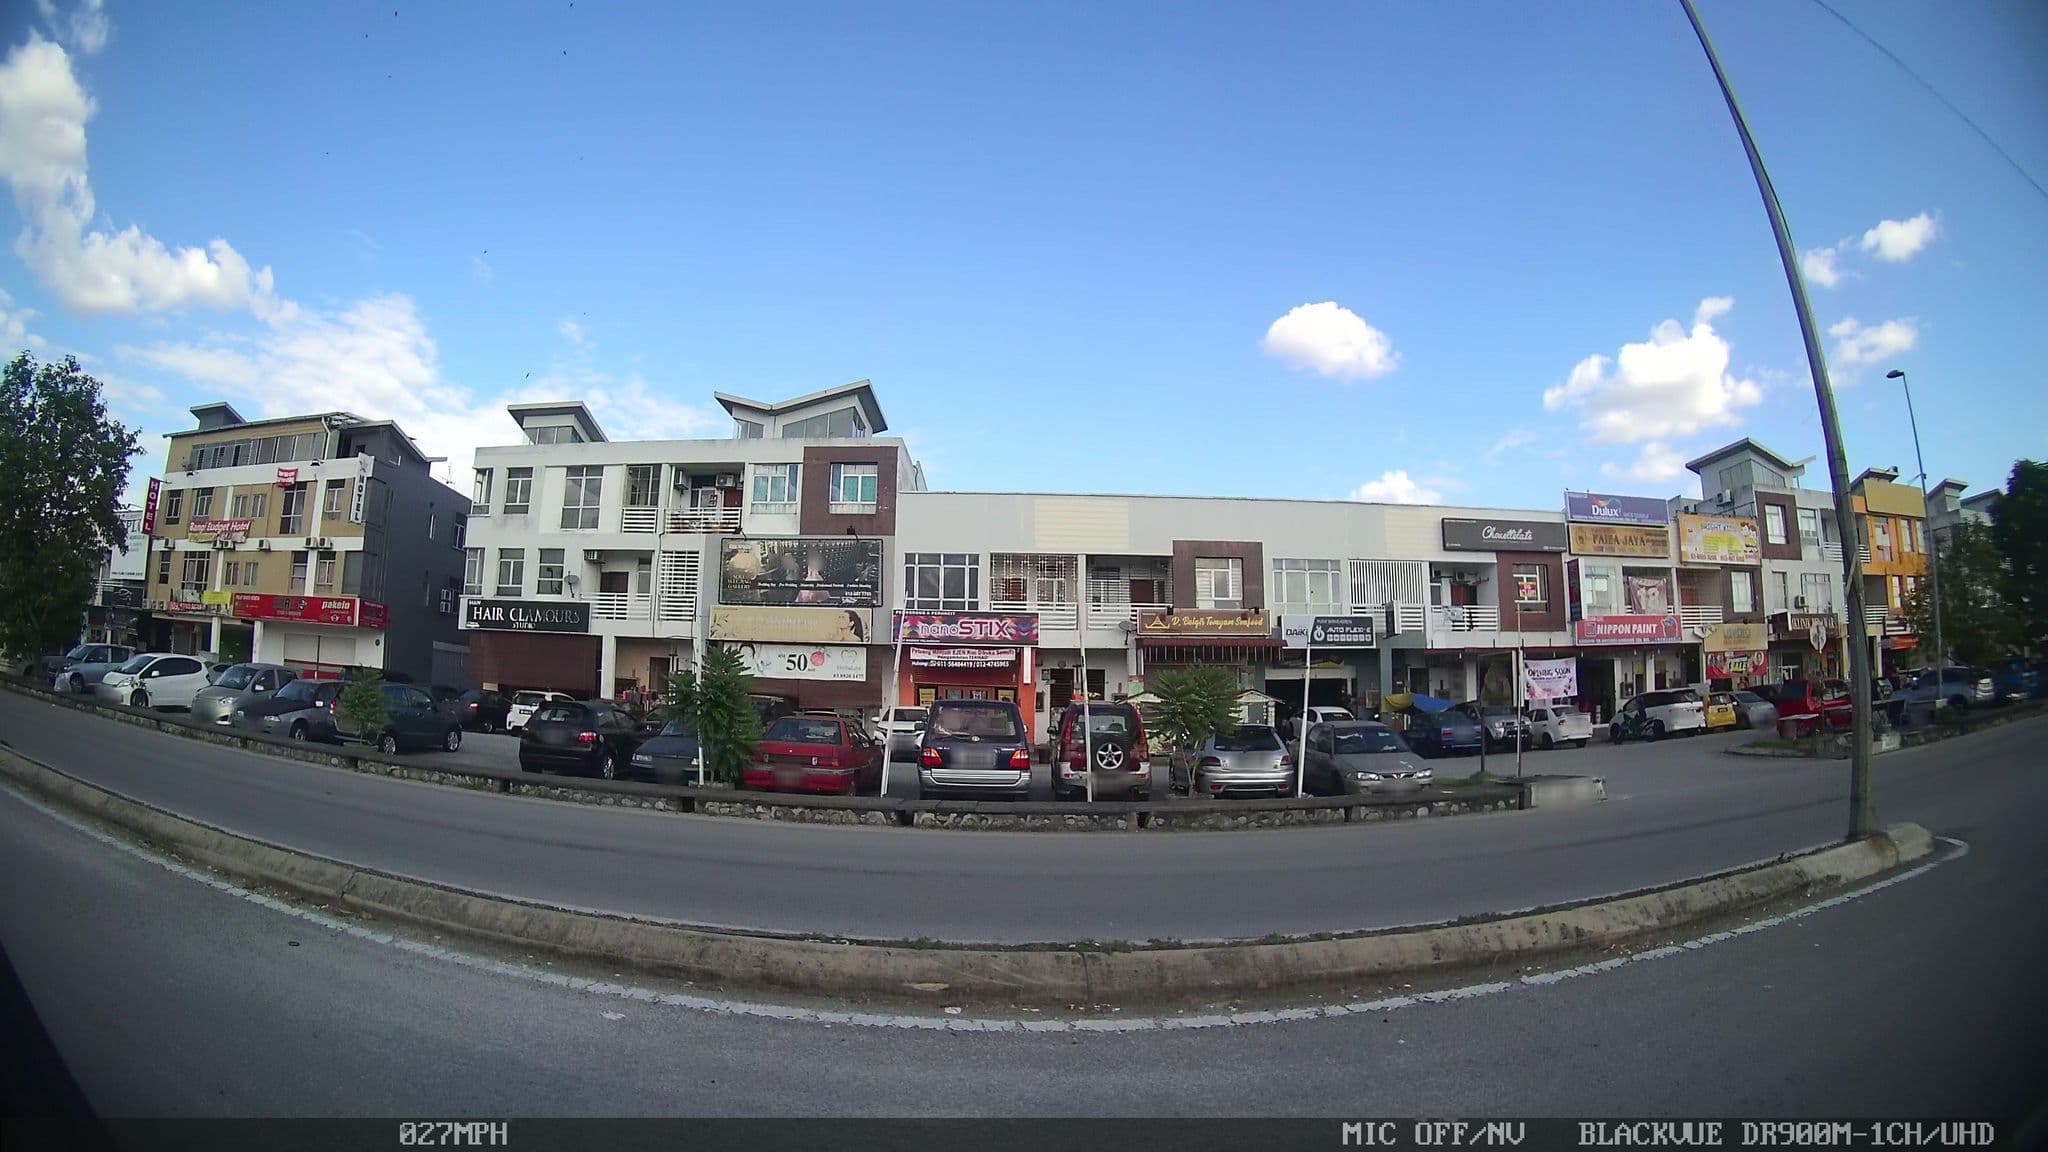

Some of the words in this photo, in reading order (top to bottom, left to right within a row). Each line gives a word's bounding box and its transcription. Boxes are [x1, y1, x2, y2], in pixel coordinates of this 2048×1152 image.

[144, 481, 158, 531] HOTEL
[354, 475, 365, 521] HOTEL
[1592, 505, 1620, 517] Dulux
[322, 600, 351, 610] pakelo
[473, 607, 505, 621] HAIR
[921, 620, 1011, 638] nanoSTIX
[1597, 624, 1631, 635] NIPPON
[1632, 623, 1657, 634] PAINT
[785, 653, 808, 672] 50
